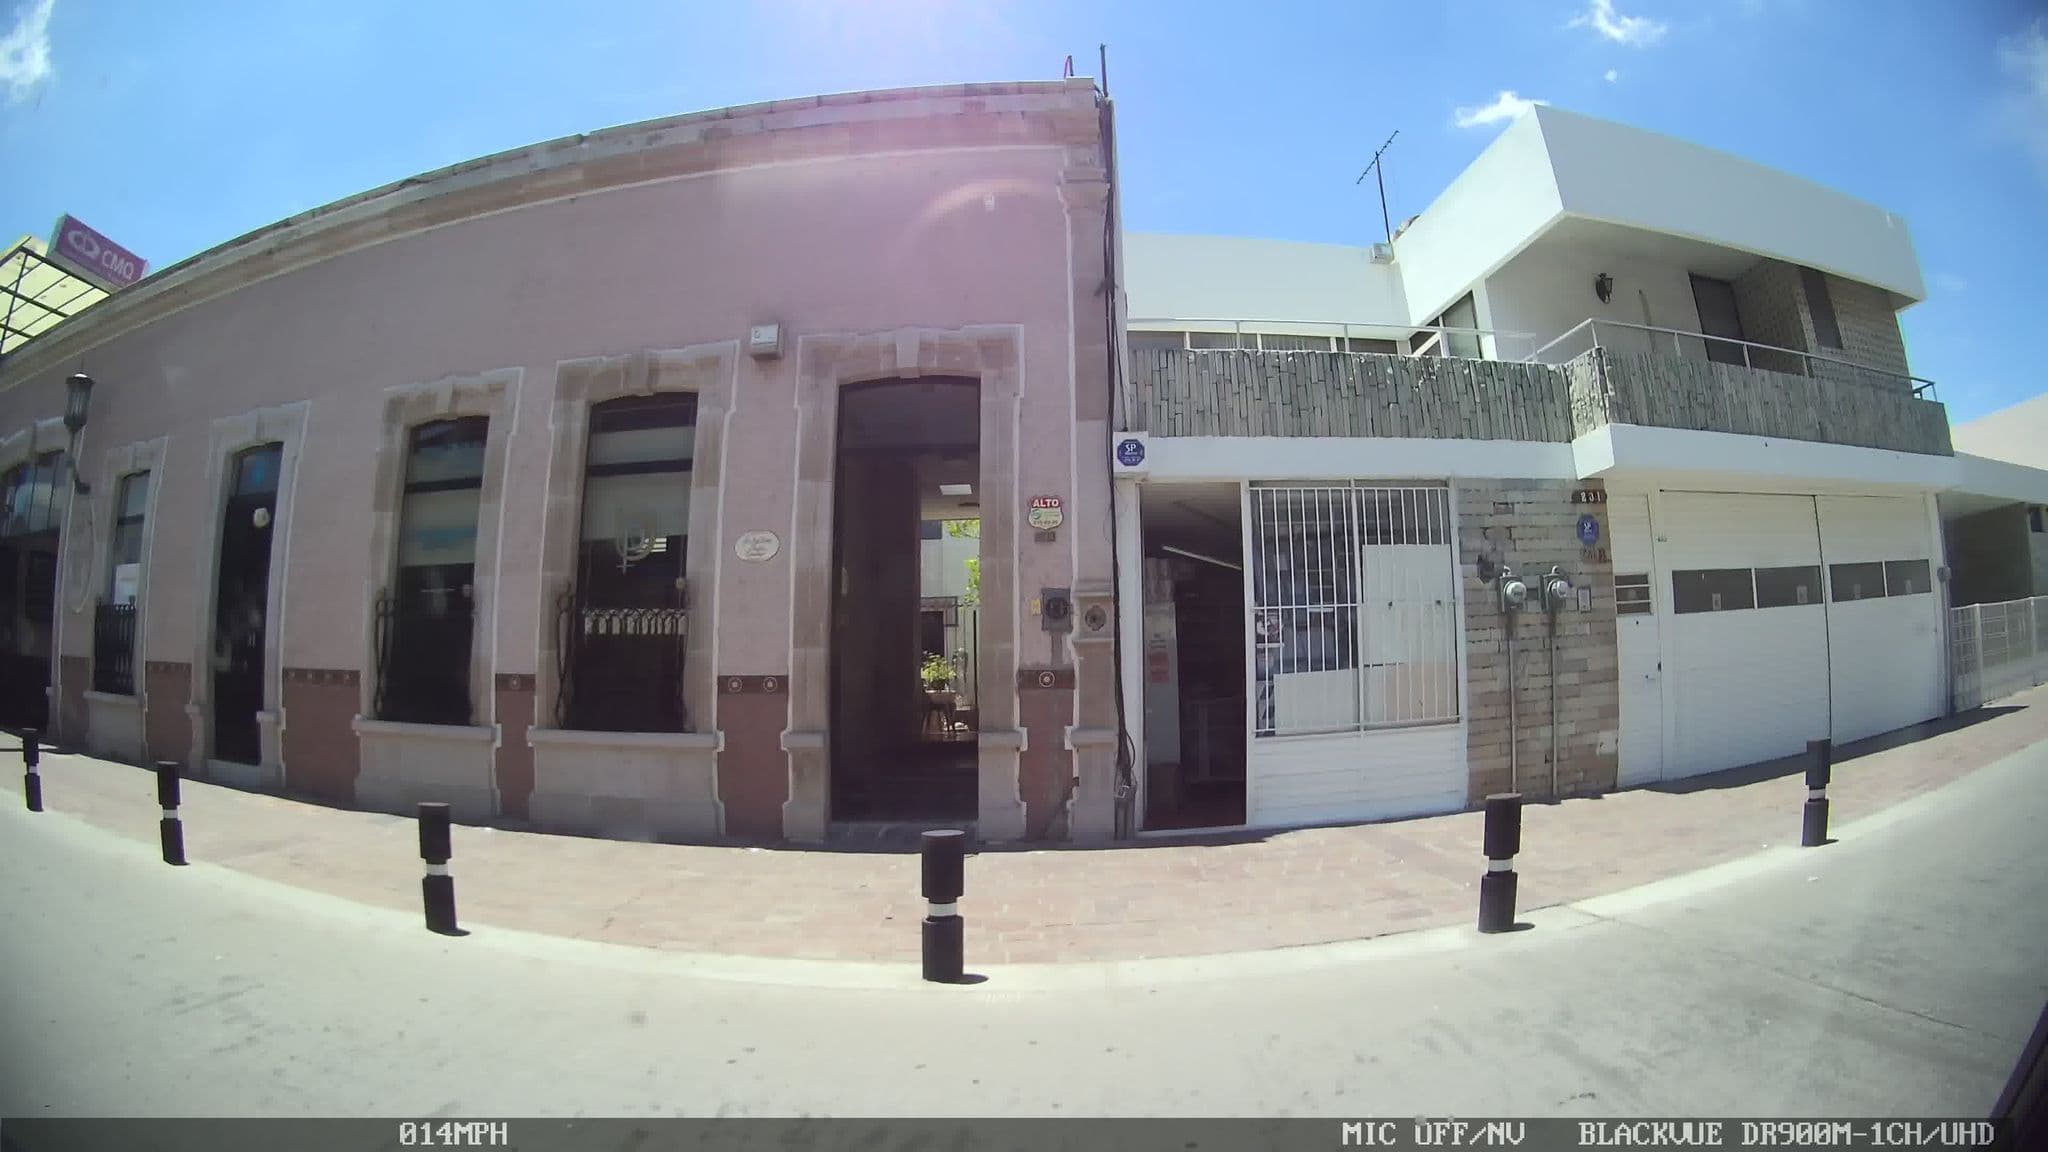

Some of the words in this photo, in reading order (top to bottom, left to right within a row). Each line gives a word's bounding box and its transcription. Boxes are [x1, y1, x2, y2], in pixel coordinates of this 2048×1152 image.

[102, 250, 134, 279] CMQ
[1032, 498, 1060, 508] ALTO
[1580, 491, 1601, 503] 231
